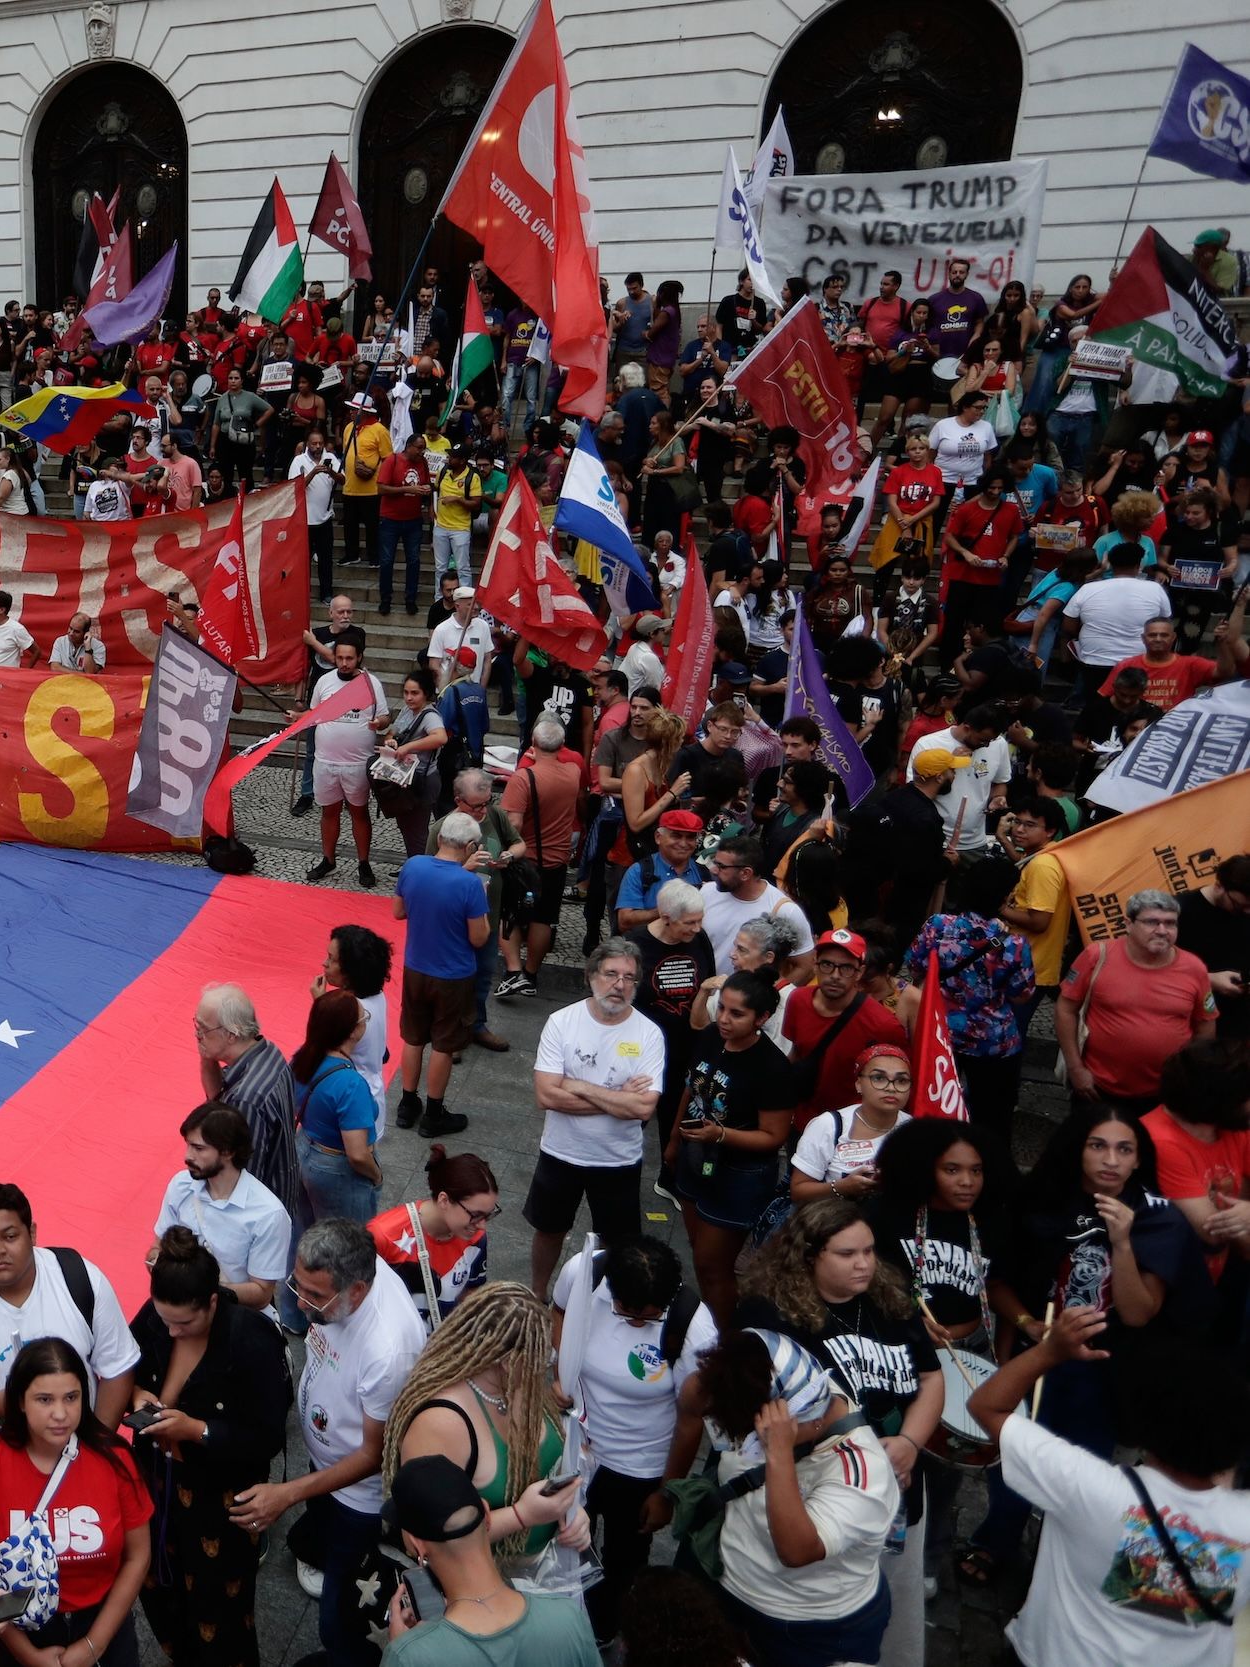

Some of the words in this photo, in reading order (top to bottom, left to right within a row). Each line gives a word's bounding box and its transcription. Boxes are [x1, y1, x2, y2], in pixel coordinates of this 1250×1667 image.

[1214, 95, 1250, 161] CS
[780, 185, 885, 214] FORA
[902, 175, 1017, 211] TRUMP
[326, 219, 351, 248] PC
[530, 218, 555, 254] ÚNIC
[806, 223, 847, 246] DA
[862, 217, 1026, 247] VENEZUELA!
[784, 360, 830, 423] PSTU
[1129, 728, 1180, 785] BRASIL
[1184, 714, 1248, 791] ANTIFA
[1153, 845, 1189, 895] junto
[1076, 893, 1097, 919] DA
[713, 1069, 730, 1089] SOL
[923, 1259, 976, 1286] OPULAR
